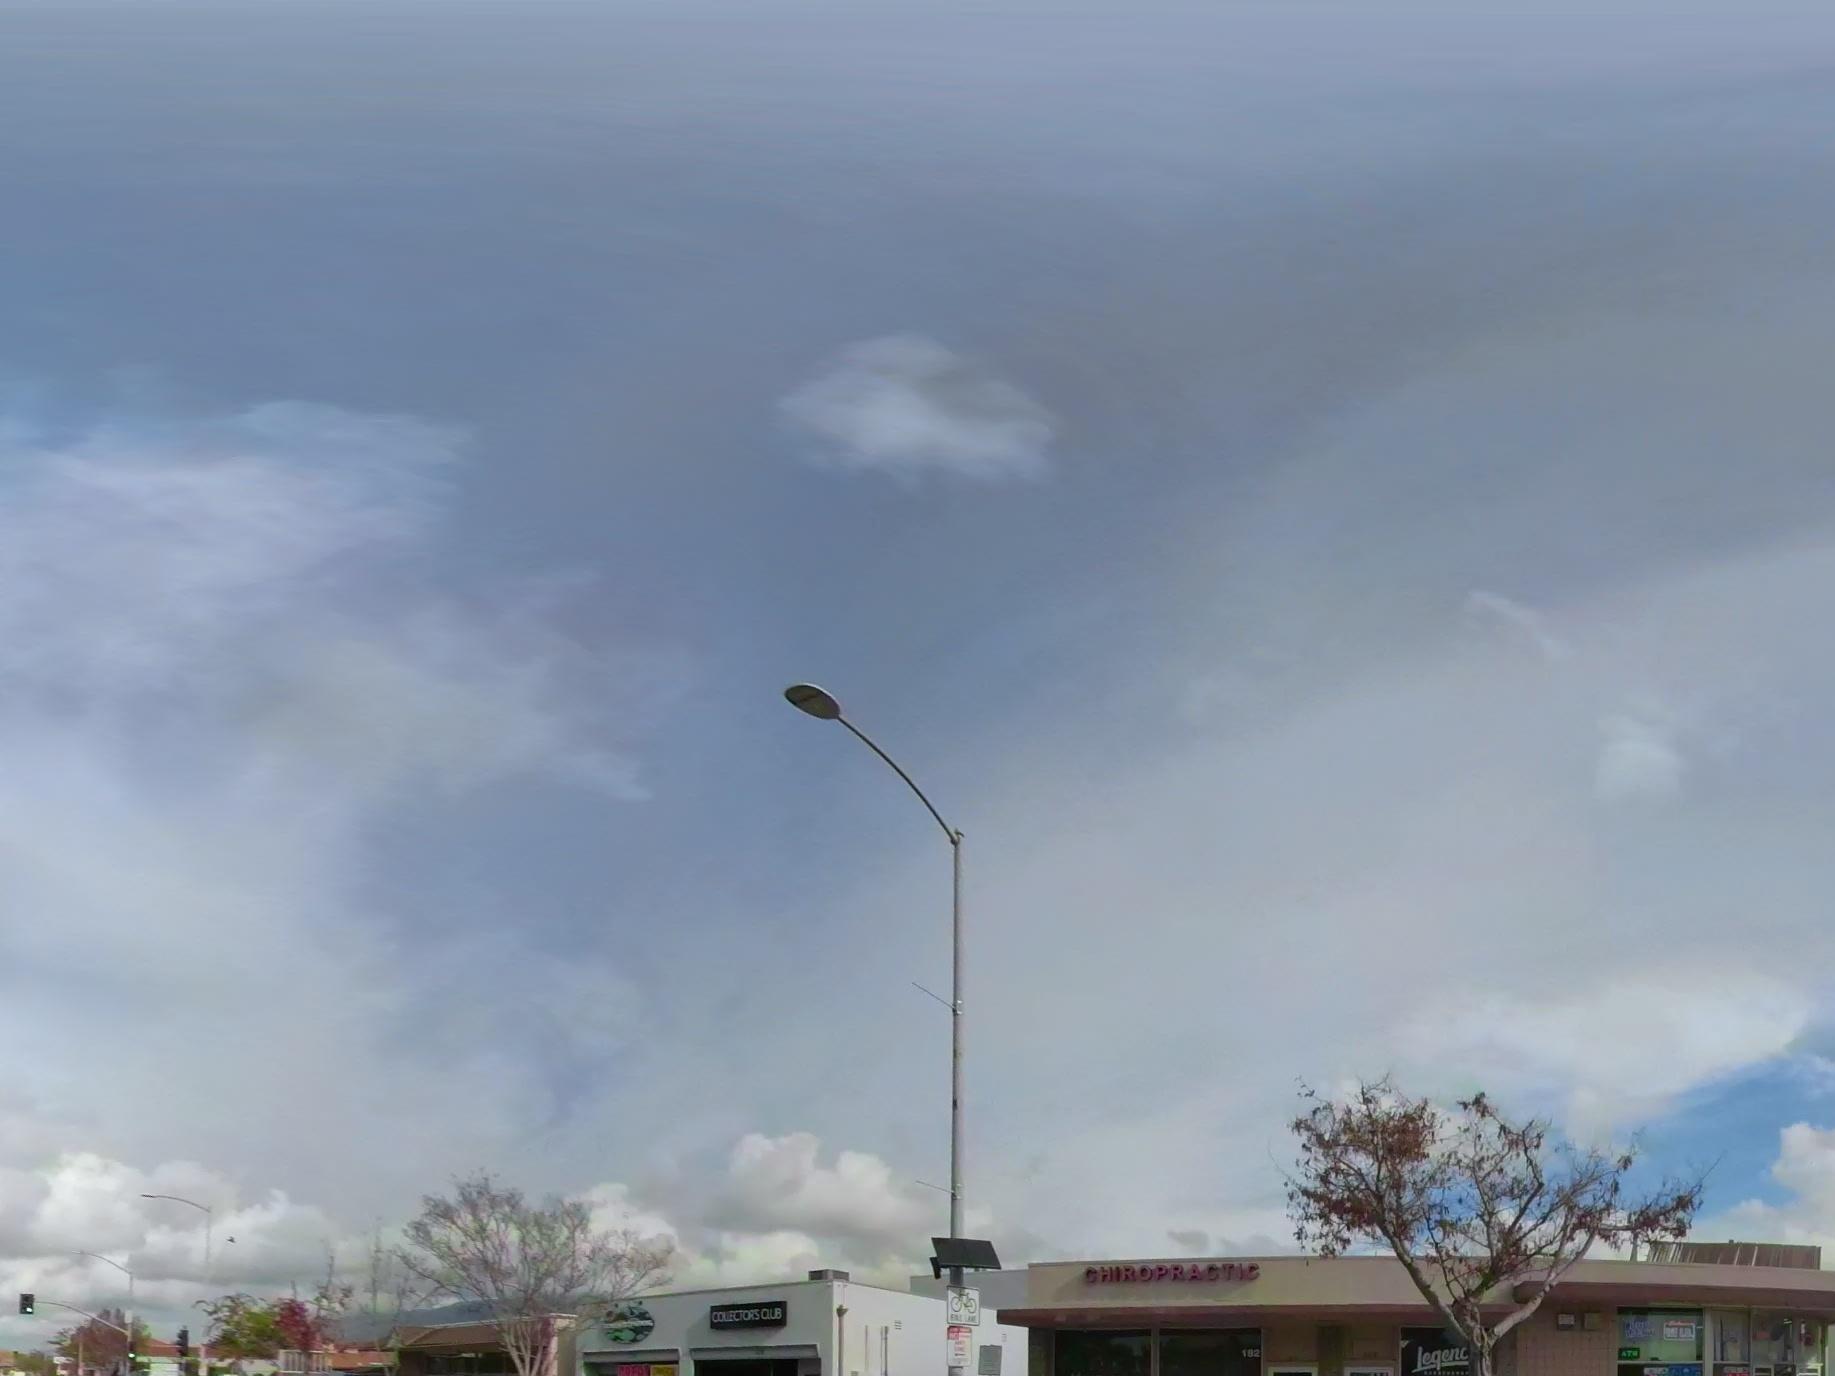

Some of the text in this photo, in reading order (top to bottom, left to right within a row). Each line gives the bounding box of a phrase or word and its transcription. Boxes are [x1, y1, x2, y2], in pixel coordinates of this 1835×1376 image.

[1085, 1263, 1260, 1283] CHIROPRACTIC
[712, 1308, 782, 1322] COLLECTOR'S CLUB
